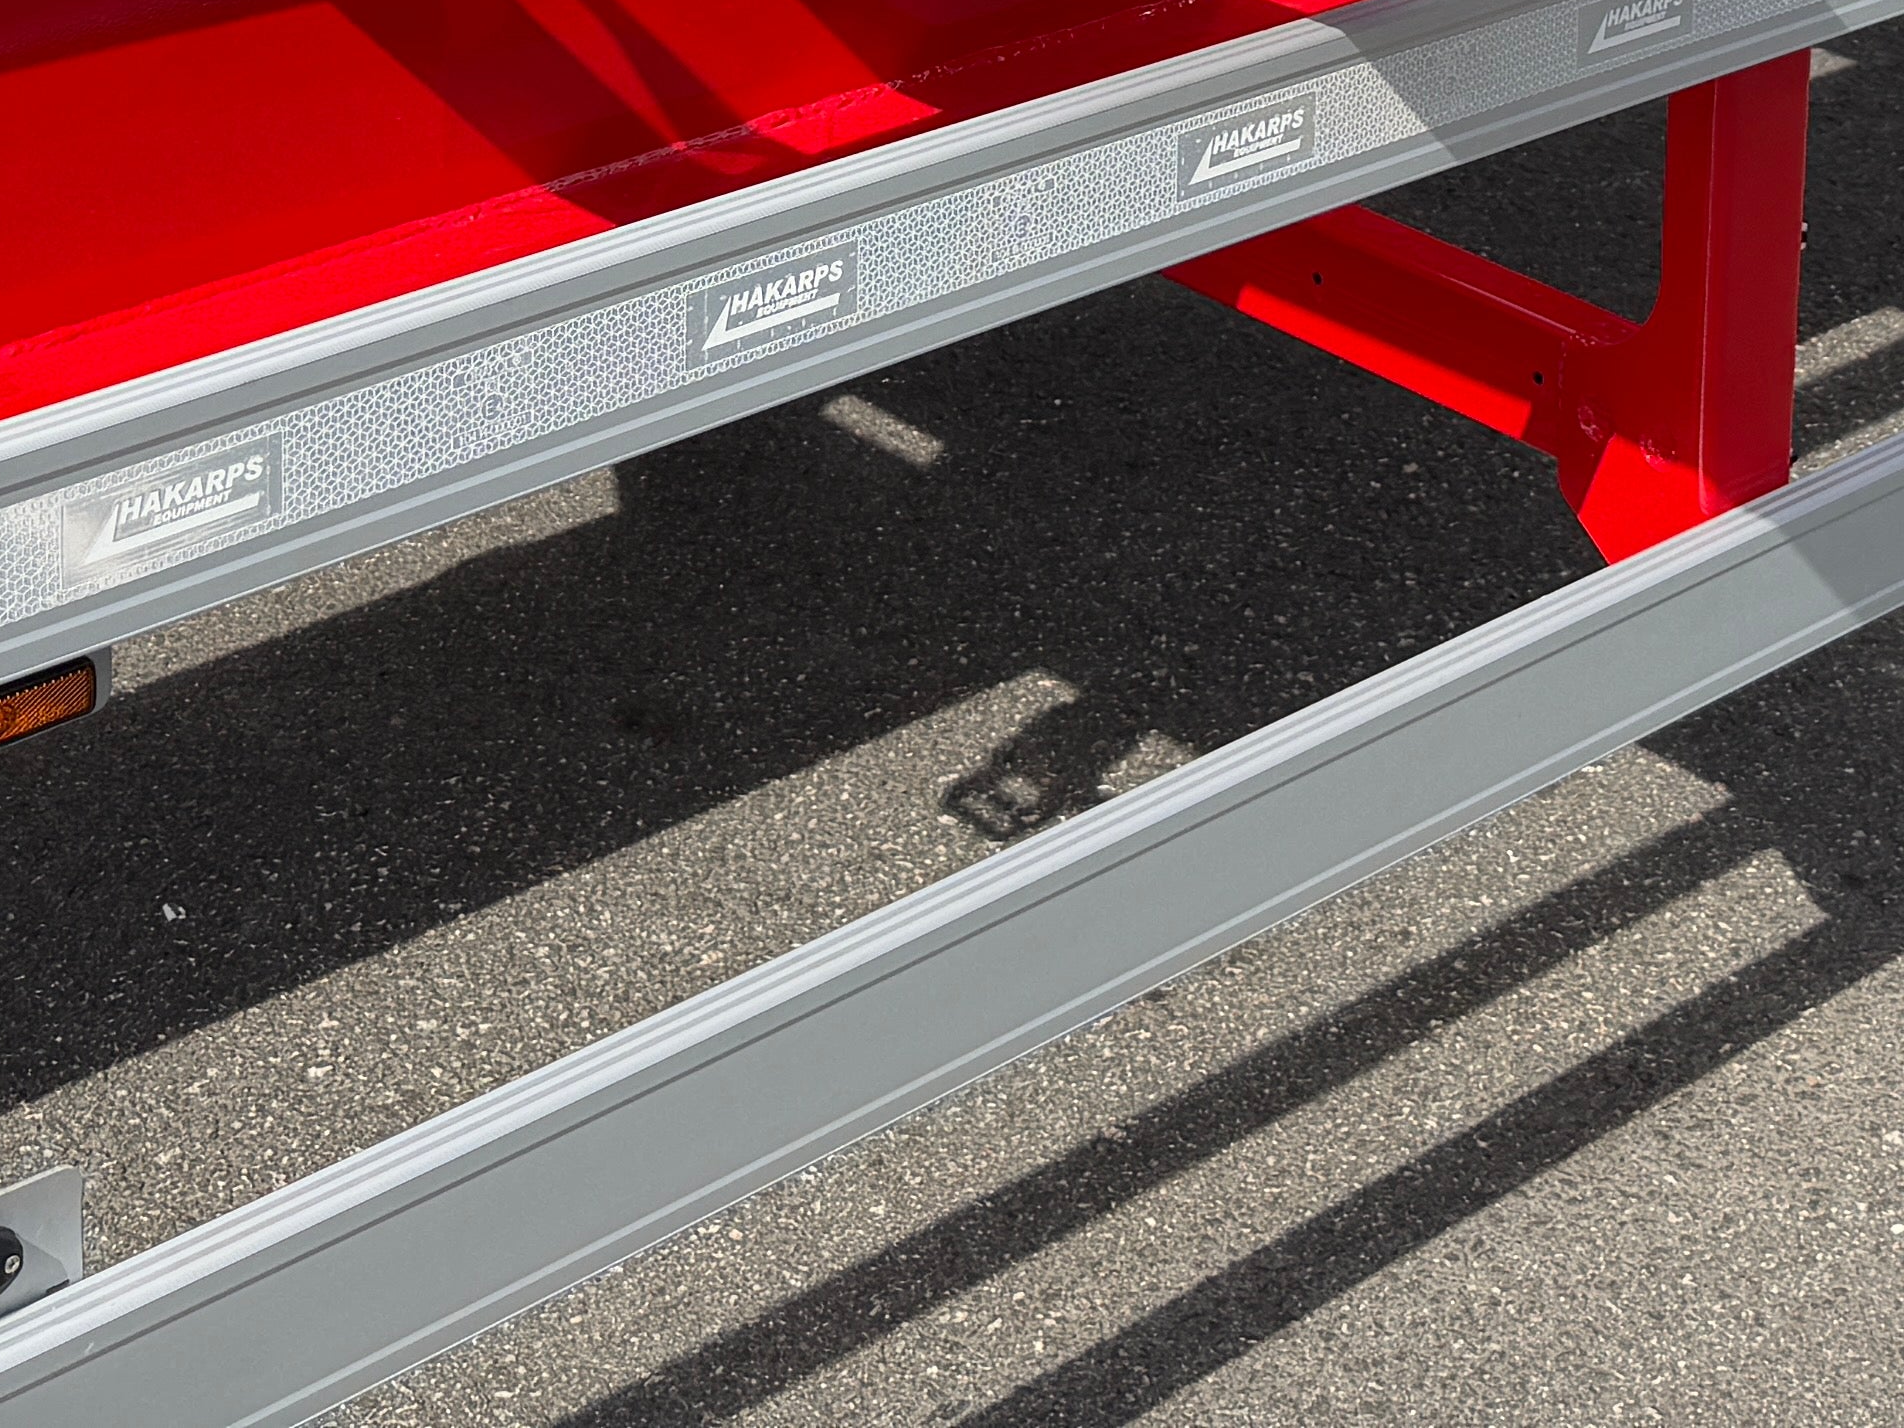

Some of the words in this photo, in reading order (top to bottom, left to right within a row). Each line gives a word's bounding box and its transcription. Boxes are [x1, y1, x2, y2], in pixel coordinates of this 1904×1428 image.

[1212, 109, 1305, 155] HAKARPS
[730, 259, 844, 316] HAKARPS
[119, 455, 266, 525] HAKARPS
[153, 488, 232, 528] EQUIPMENT
